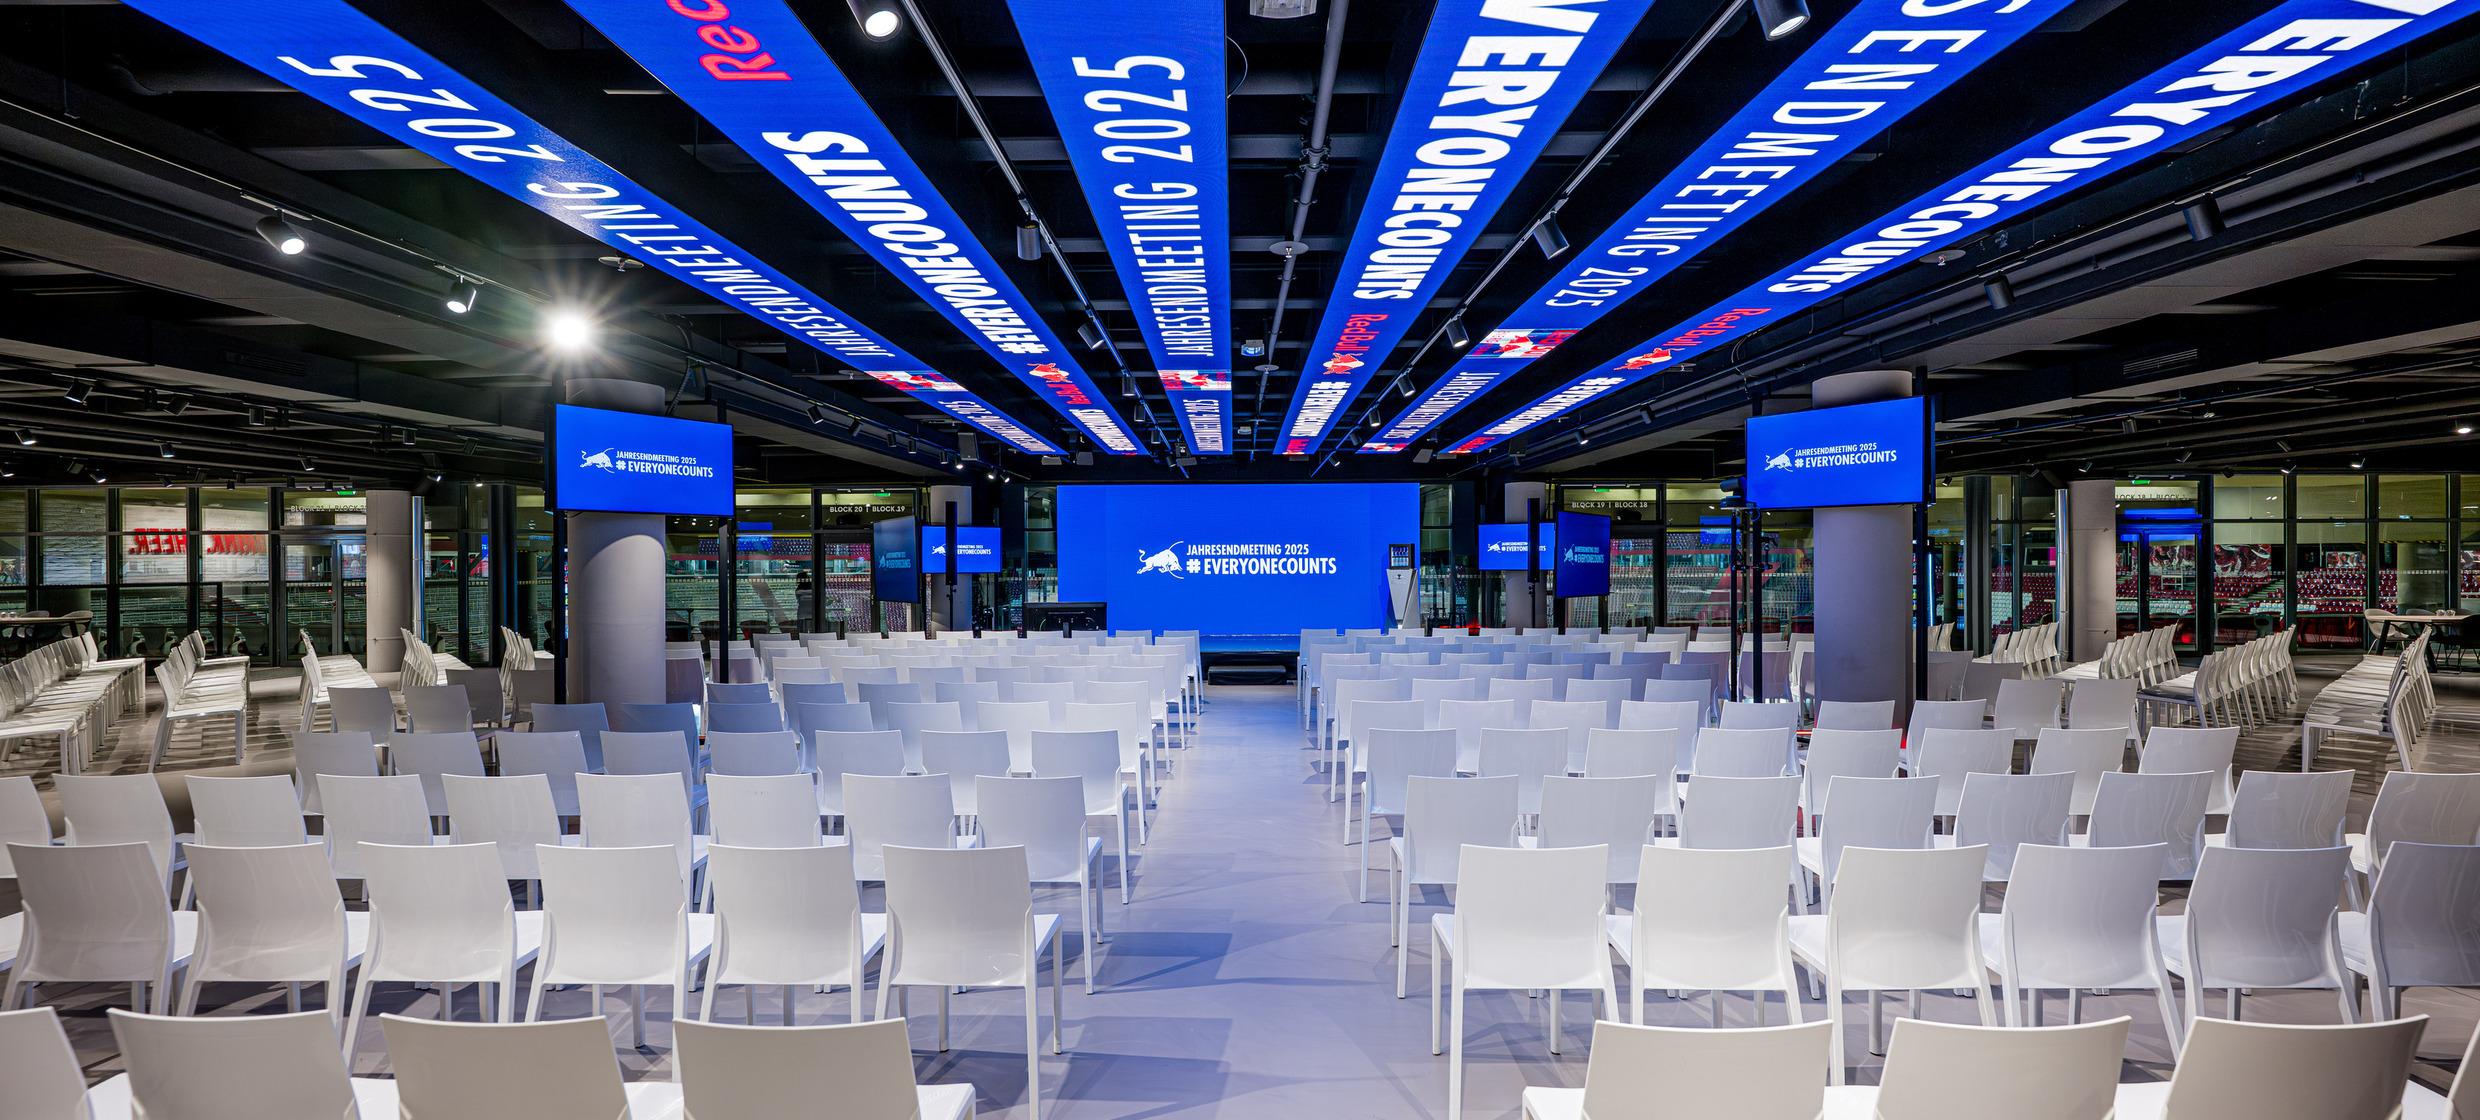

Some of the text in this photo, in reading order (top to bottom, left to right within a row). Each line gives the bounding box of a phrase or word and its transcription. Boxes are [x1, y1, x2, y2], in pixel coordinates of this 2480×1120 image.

[277, 54, 896, 357] JAHRESENDMEETING 2025
[1072, 55, 1214, 356] JAHRESENDMEETING 2025
[762, 130, 1049, 354] #EVERYONECOUNTS
[1546, 267, 1648, 307] 2025
[616, 451, 697, 465] JAHRESENDMEETING 2025
[1795, 442, 1877, 457] JAHRESENDMEETING 2025
[335, 504, 358, 512] BLOCK
[1187, 543, 1310, 556] JAHRESENDMEETING 2025
